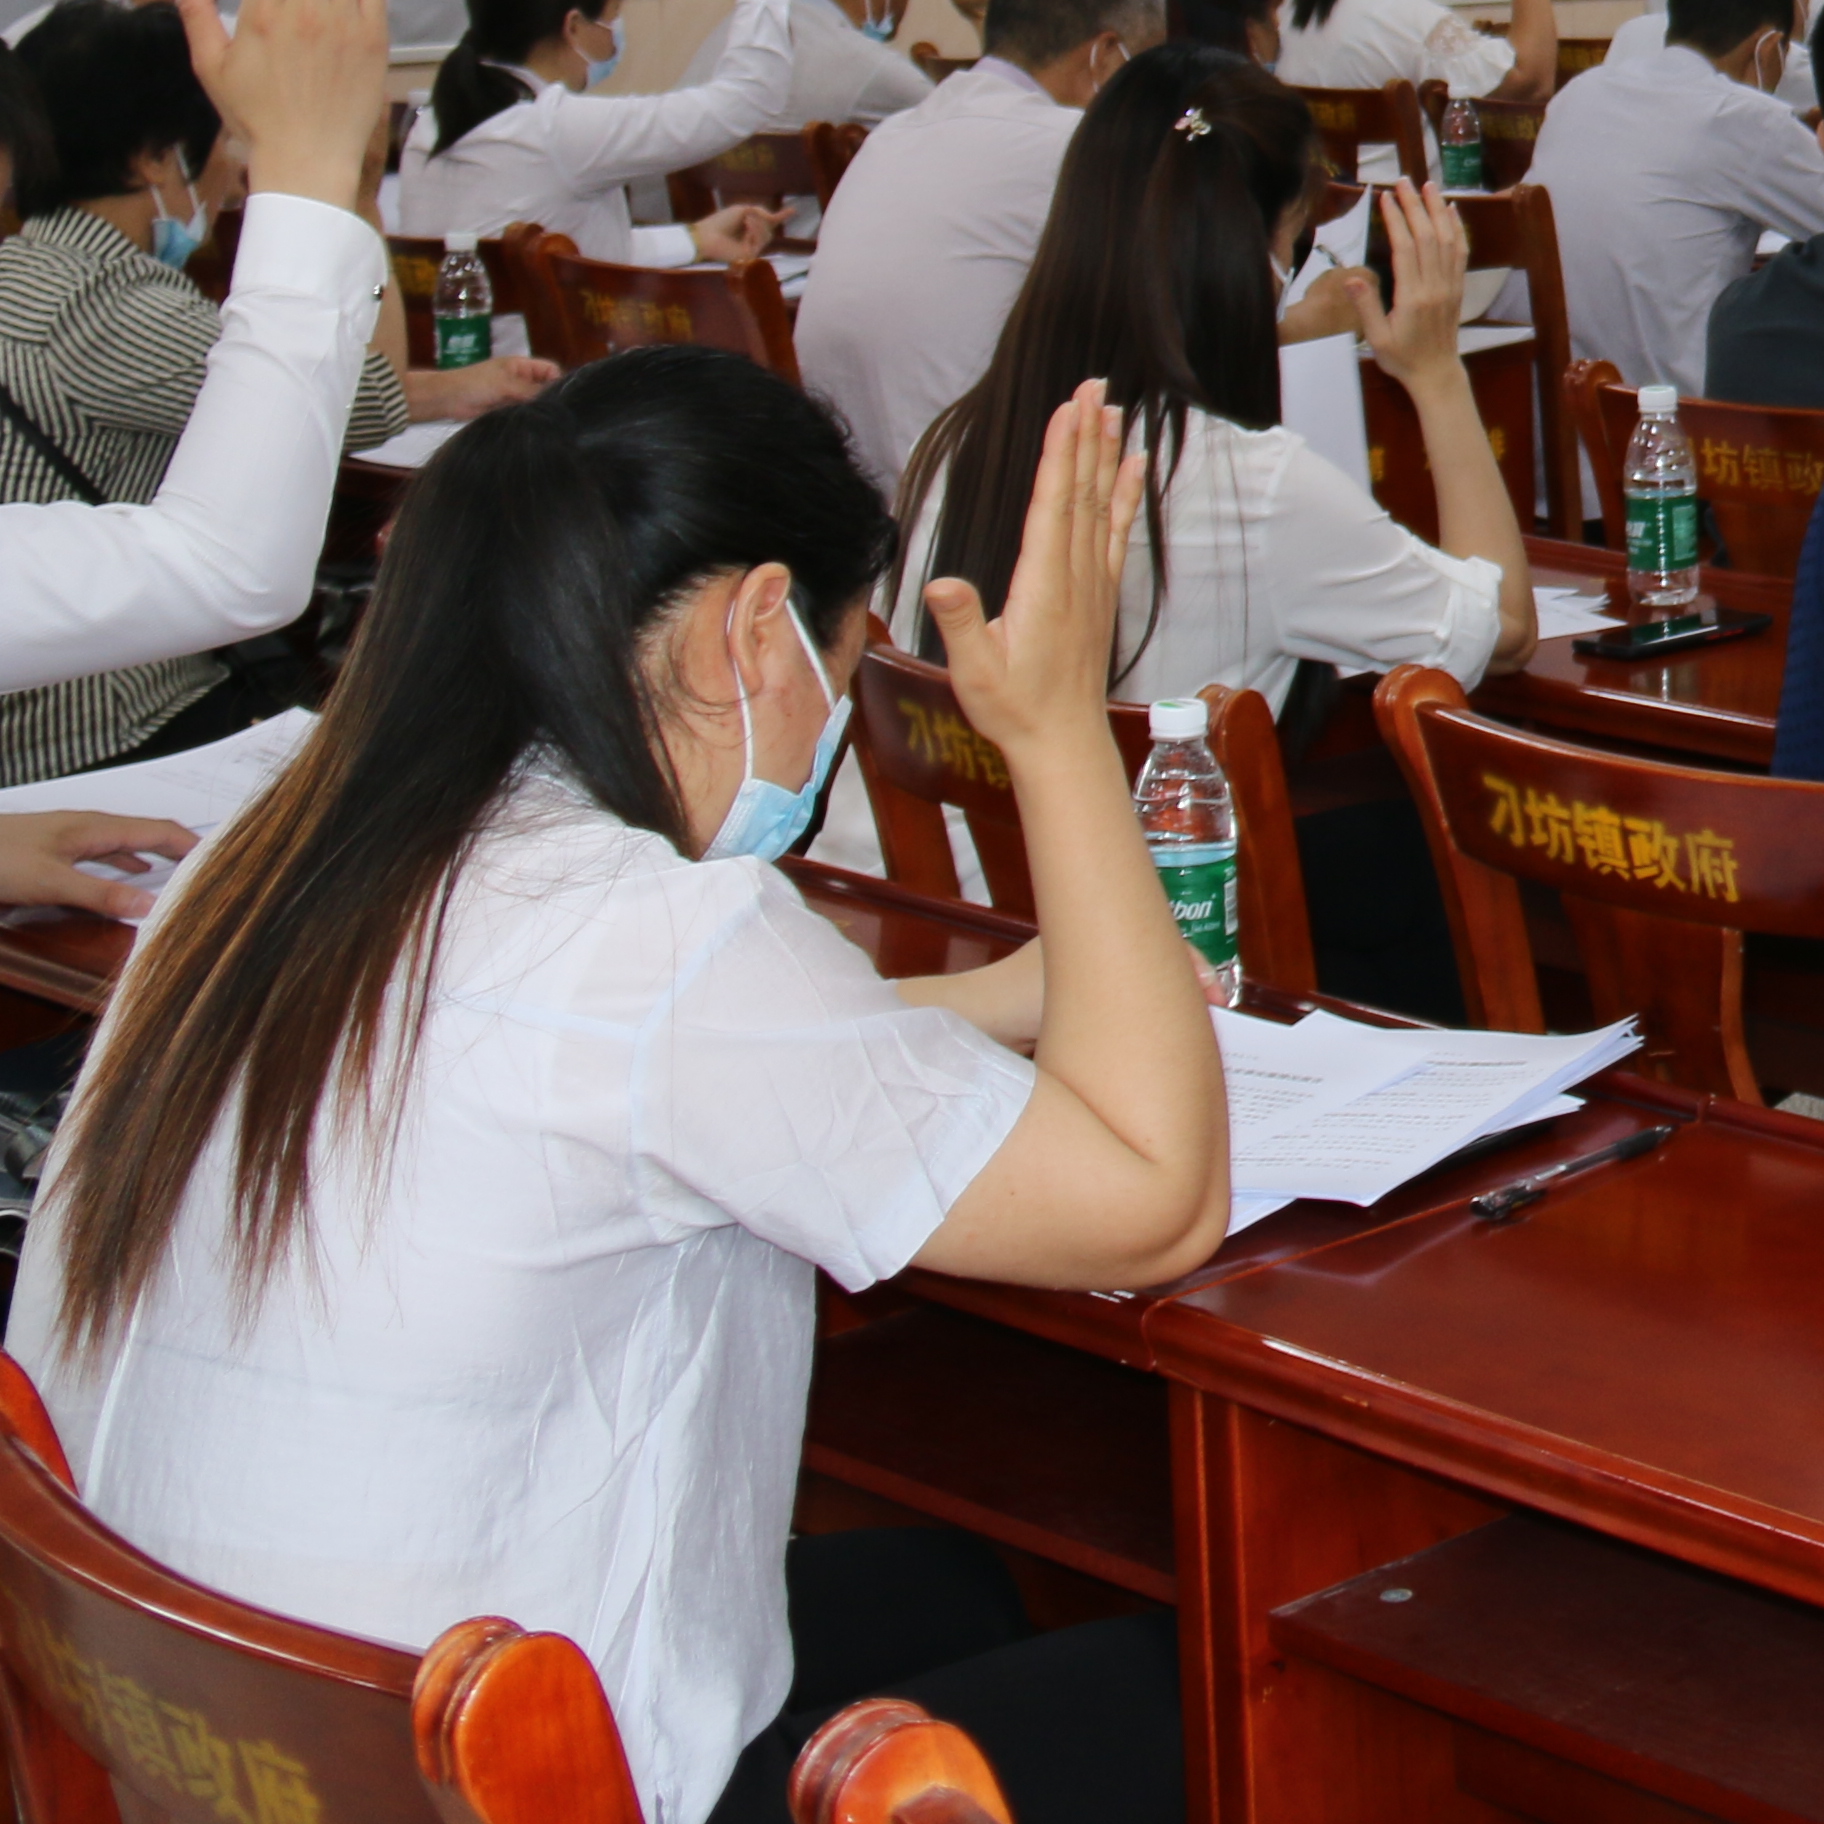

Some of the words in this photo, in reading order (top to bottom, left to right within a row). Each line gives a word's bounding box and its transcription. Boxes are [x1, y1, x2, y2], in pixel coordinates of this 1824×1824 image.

[1483, 775, 1740, 903] 刁坊镇政府
